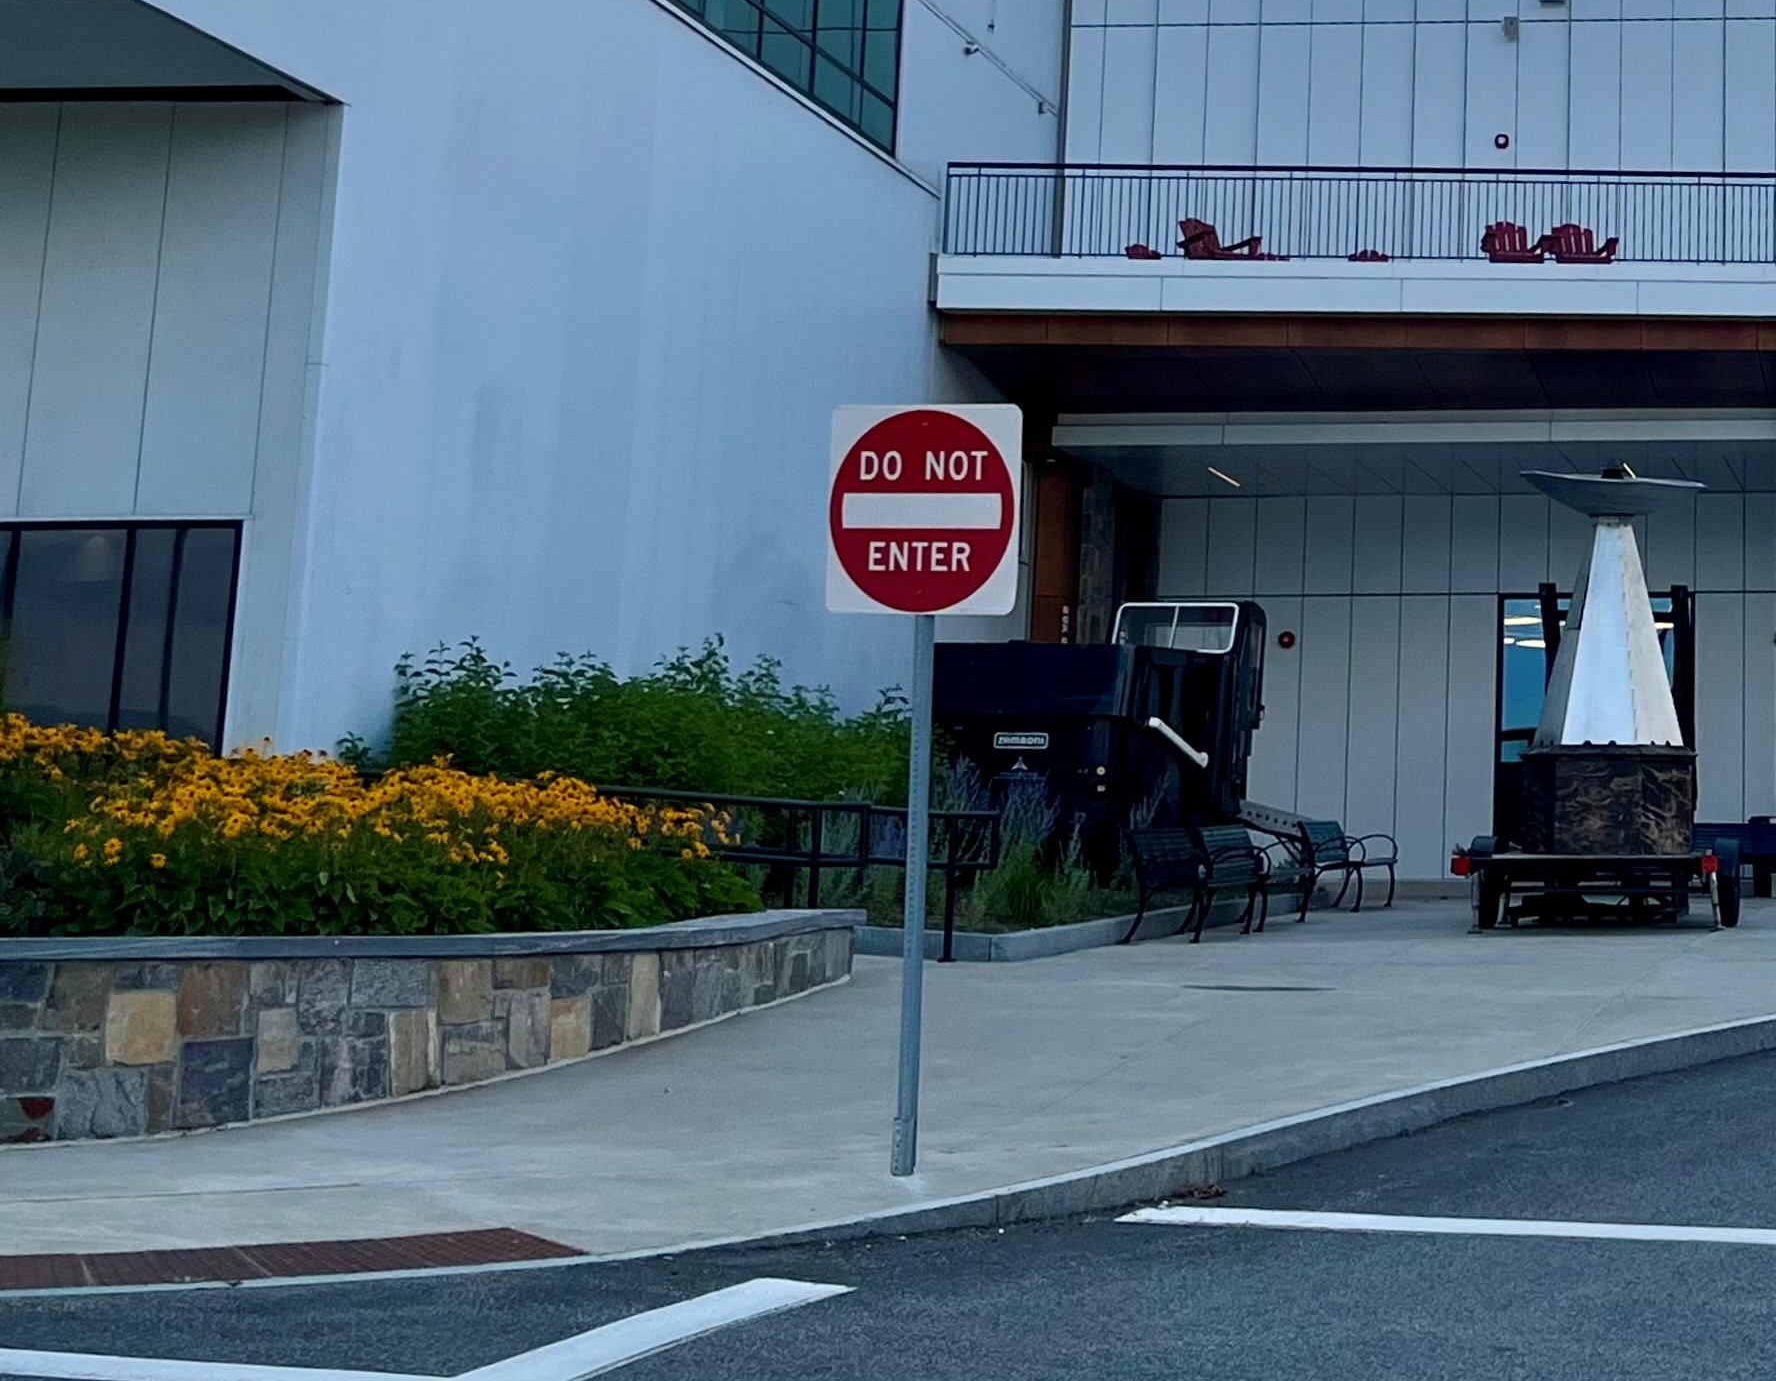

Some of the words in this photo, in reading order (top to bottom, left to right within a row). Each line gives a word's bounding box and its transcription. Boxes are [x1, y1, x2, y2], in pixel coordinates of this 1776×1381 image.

[859, 450, 902, 480] DO
[925, 450, 988, 480] NOT
[868, 541, 971, 571] ENTER
